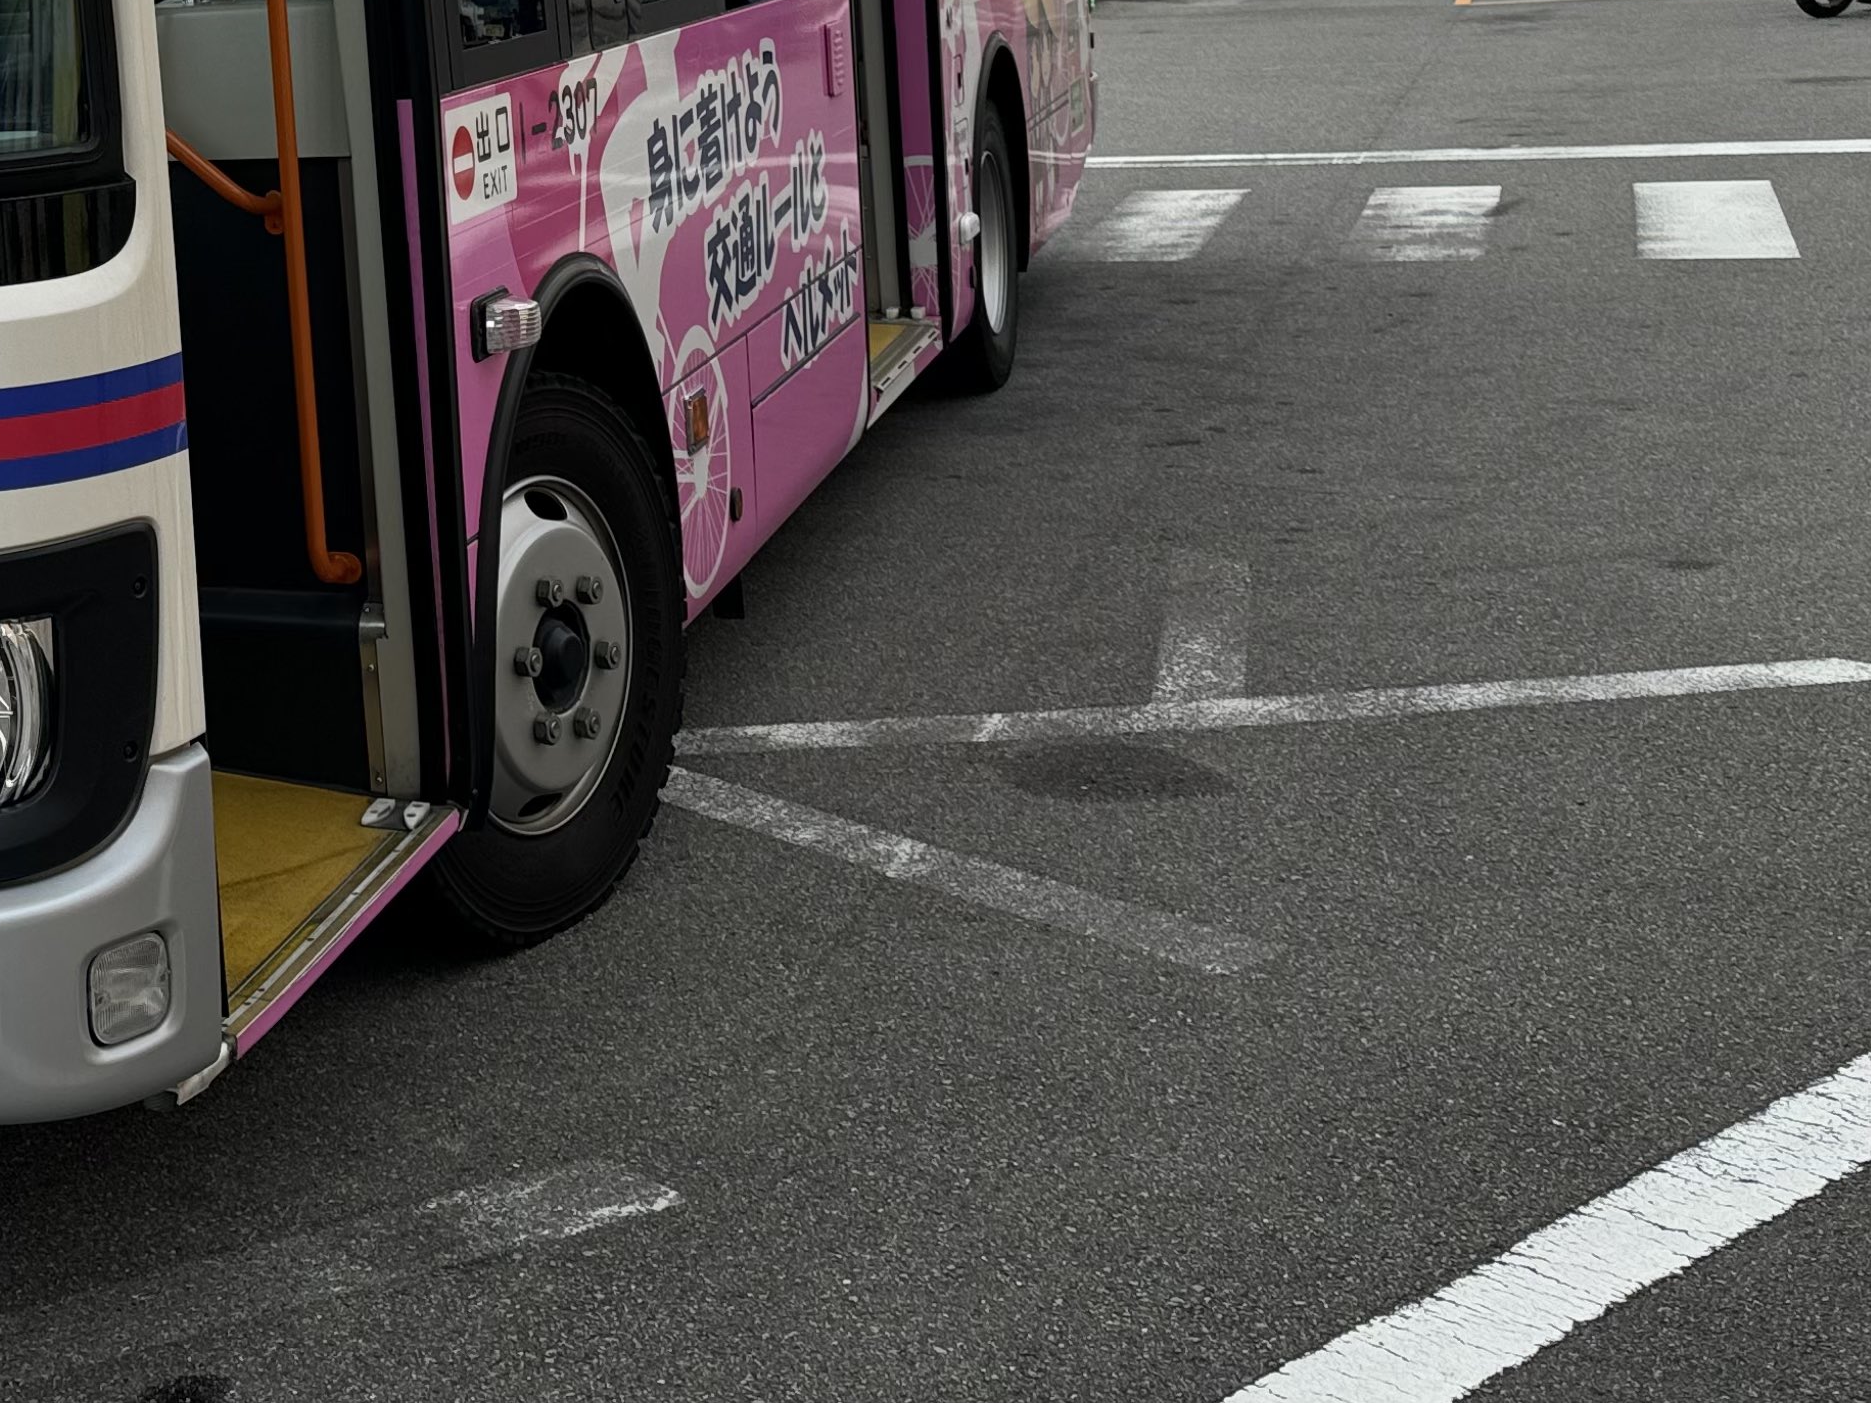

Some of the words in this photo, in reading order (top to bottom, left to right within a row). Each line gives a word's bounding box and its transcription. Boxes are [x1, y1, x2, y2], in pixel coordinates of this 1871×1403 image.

[476, 106, 511, 163] 出口
[483, 165, 508, 199] EXIT
[646, 50, 780, 234] 身に着けよう
[707, 142, 828, 328] 交通ルールと
[783, 228, 857, 359] ヘルメット
